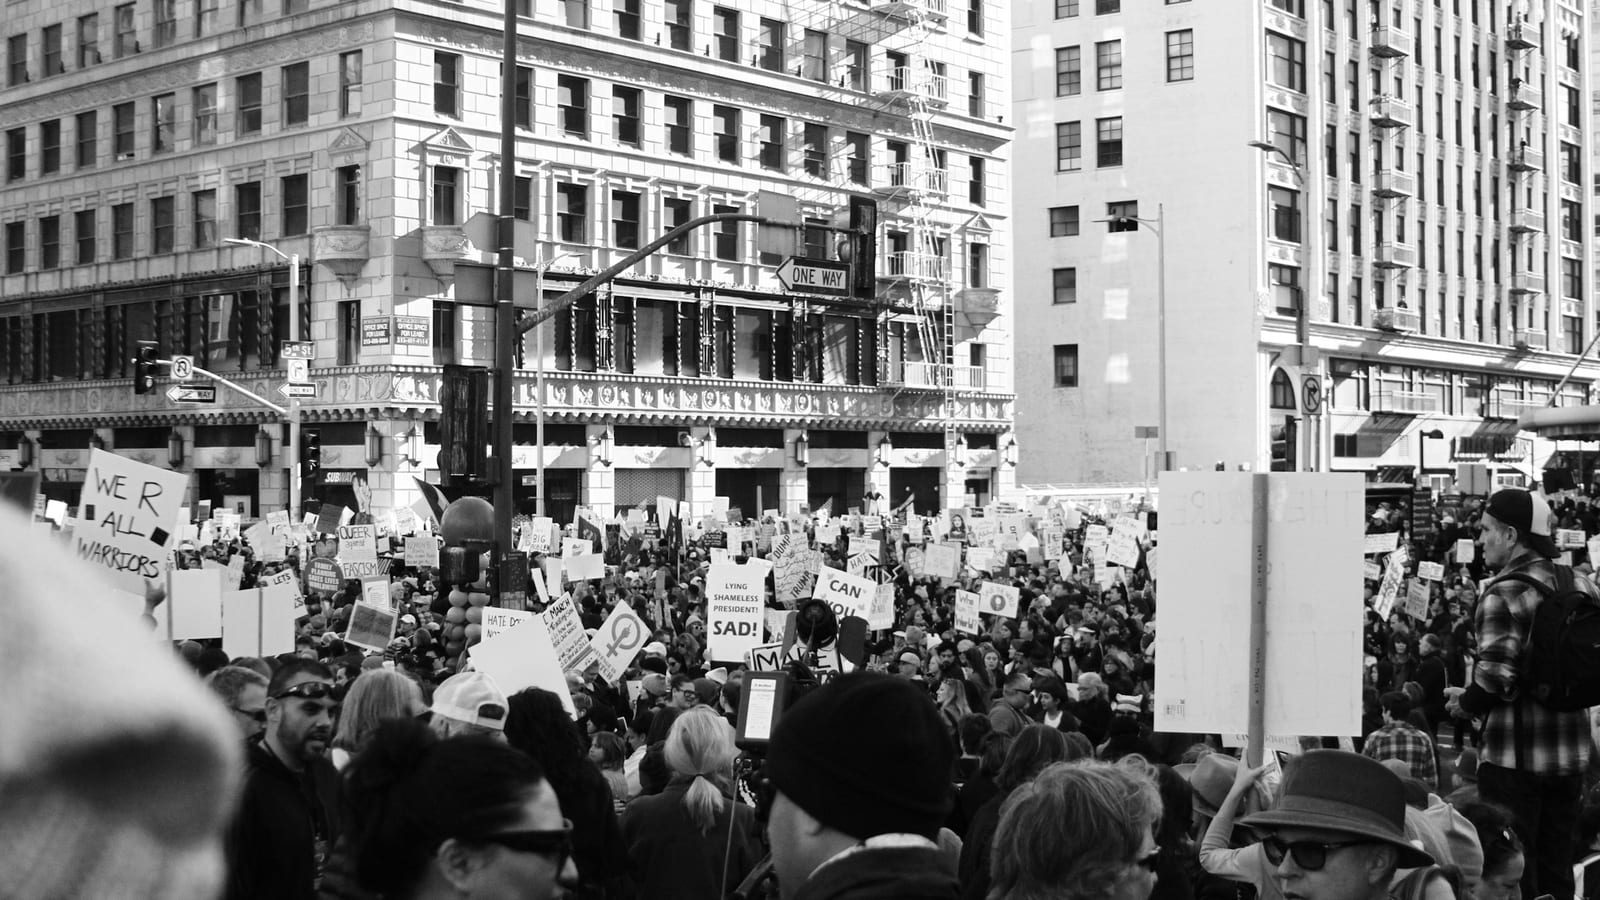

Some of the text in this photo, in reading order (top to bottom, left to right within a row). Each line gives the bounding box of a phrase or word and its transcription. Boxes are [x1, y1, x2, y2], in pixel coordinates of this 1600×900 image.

[792, 266, 843, 287] ONE WAY
[197, 391, 212, 399] WAY
[325, 471, 356, 483] SUBWAY
[95, 467, 163, 517] WE R
[101, 511, 146, 537] ALL
[340, 526, 371, 540] QUEER
[773, 534, 791, 559] DUMP
[78, 537, 159, 579] WARRIORS
[849, 551, 869, 570] HATE
[343, 562, 378, 577] FASCISM
[866, 564, 902, 585] KIDS
[725, 583, 748, 591] LYING
[790, 570, 811, 598] TRUMP
[829, 579, 862, 599] CAN
[713, 593, 759, 602] SHAMELESS
[549, 597, 571, 619] MARCH
[713, 604, 759, 614] PRESIDENT!
[488, 615, 506, 628] HATE
[712, 620, 758, 637] SAD!
